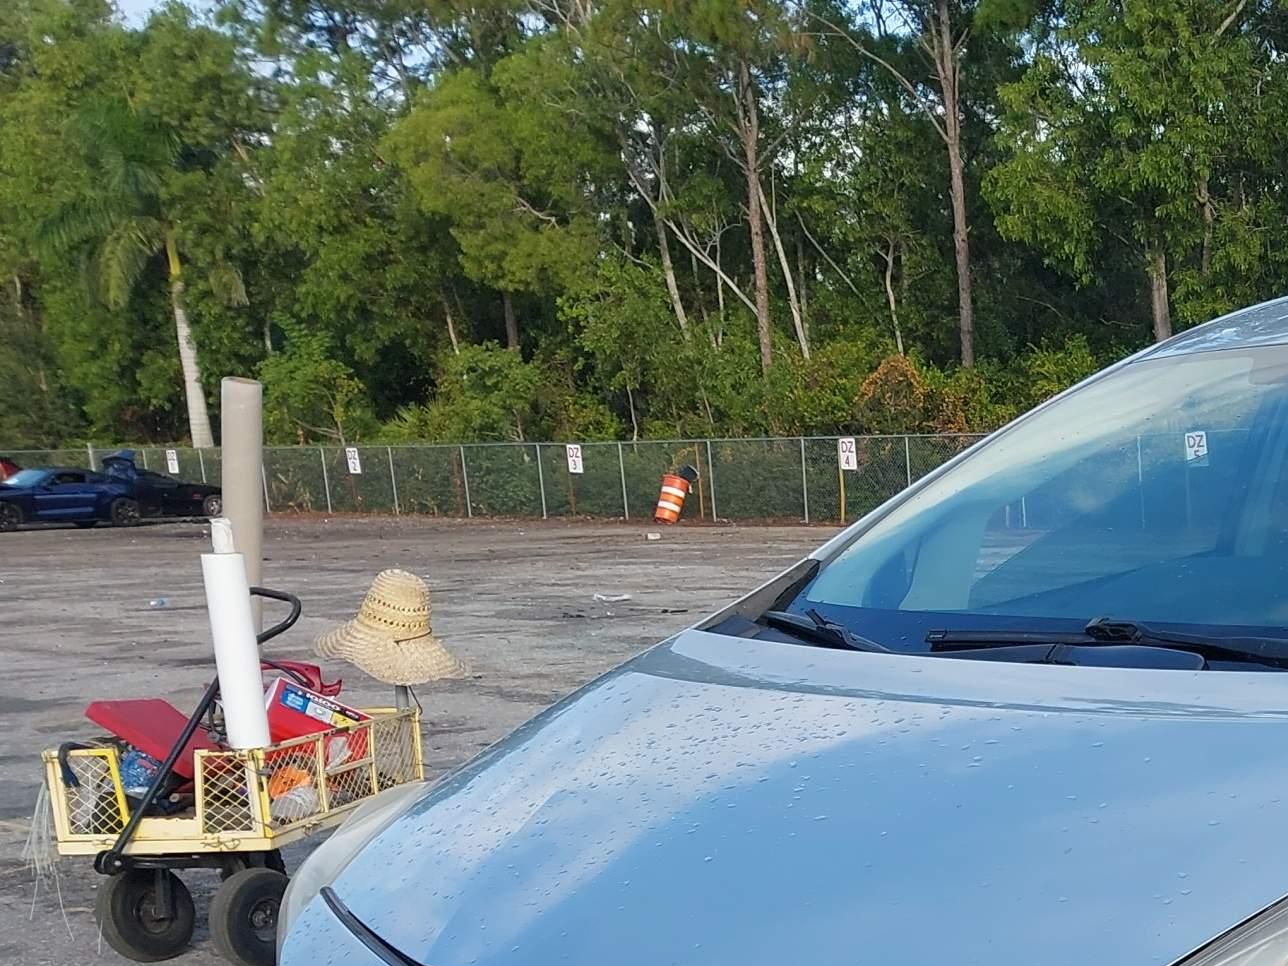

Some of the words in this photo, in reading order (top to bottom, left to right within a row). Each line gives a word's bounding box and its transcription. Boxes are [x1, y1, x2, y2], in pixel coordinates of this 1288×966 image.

[840, 440, 855, 454] DZ
[1186, 434, 1205, 449] DZ
[568, 447, 580, 458] DZ
[351, 461, 358, 472] 2
[571, 459, 577, 470] 3
[844, 455, 851, 468] 4
